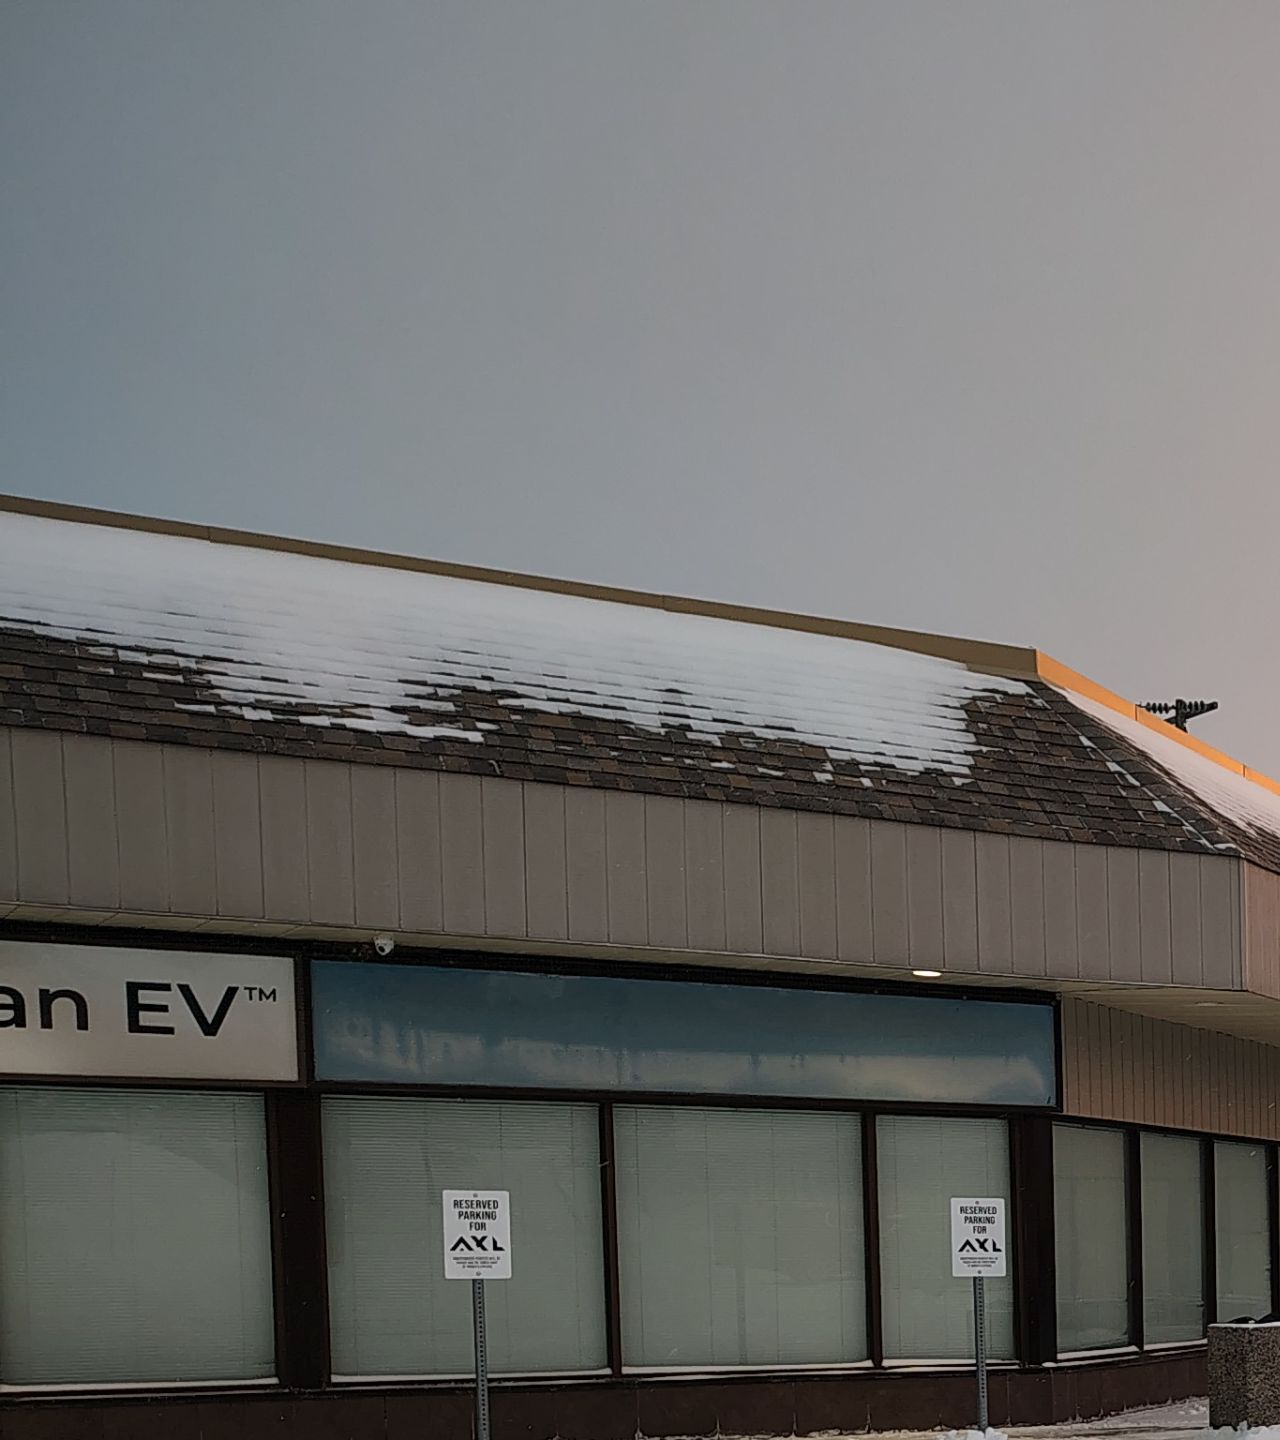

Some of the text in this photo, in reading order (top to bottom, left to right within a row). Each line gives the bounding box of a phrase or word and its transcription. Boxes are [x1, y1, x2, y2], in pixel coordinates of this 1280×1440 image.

[0, 985, 89, 1031] an
[453, 1199, 499, 1210] RESERVED
[458, 1210, 497, 1220] PARKING
[960, 1206, 997, 1215] RESERVED
[964, 1216, 996, 1224] PARKING
[469, 1221, 487, 1231] FOR
[973, 1225, 987, 1234] FOR
[450, 1235, 505, 1251] AXL
[958, 1238, 1002, 1252] AXL
